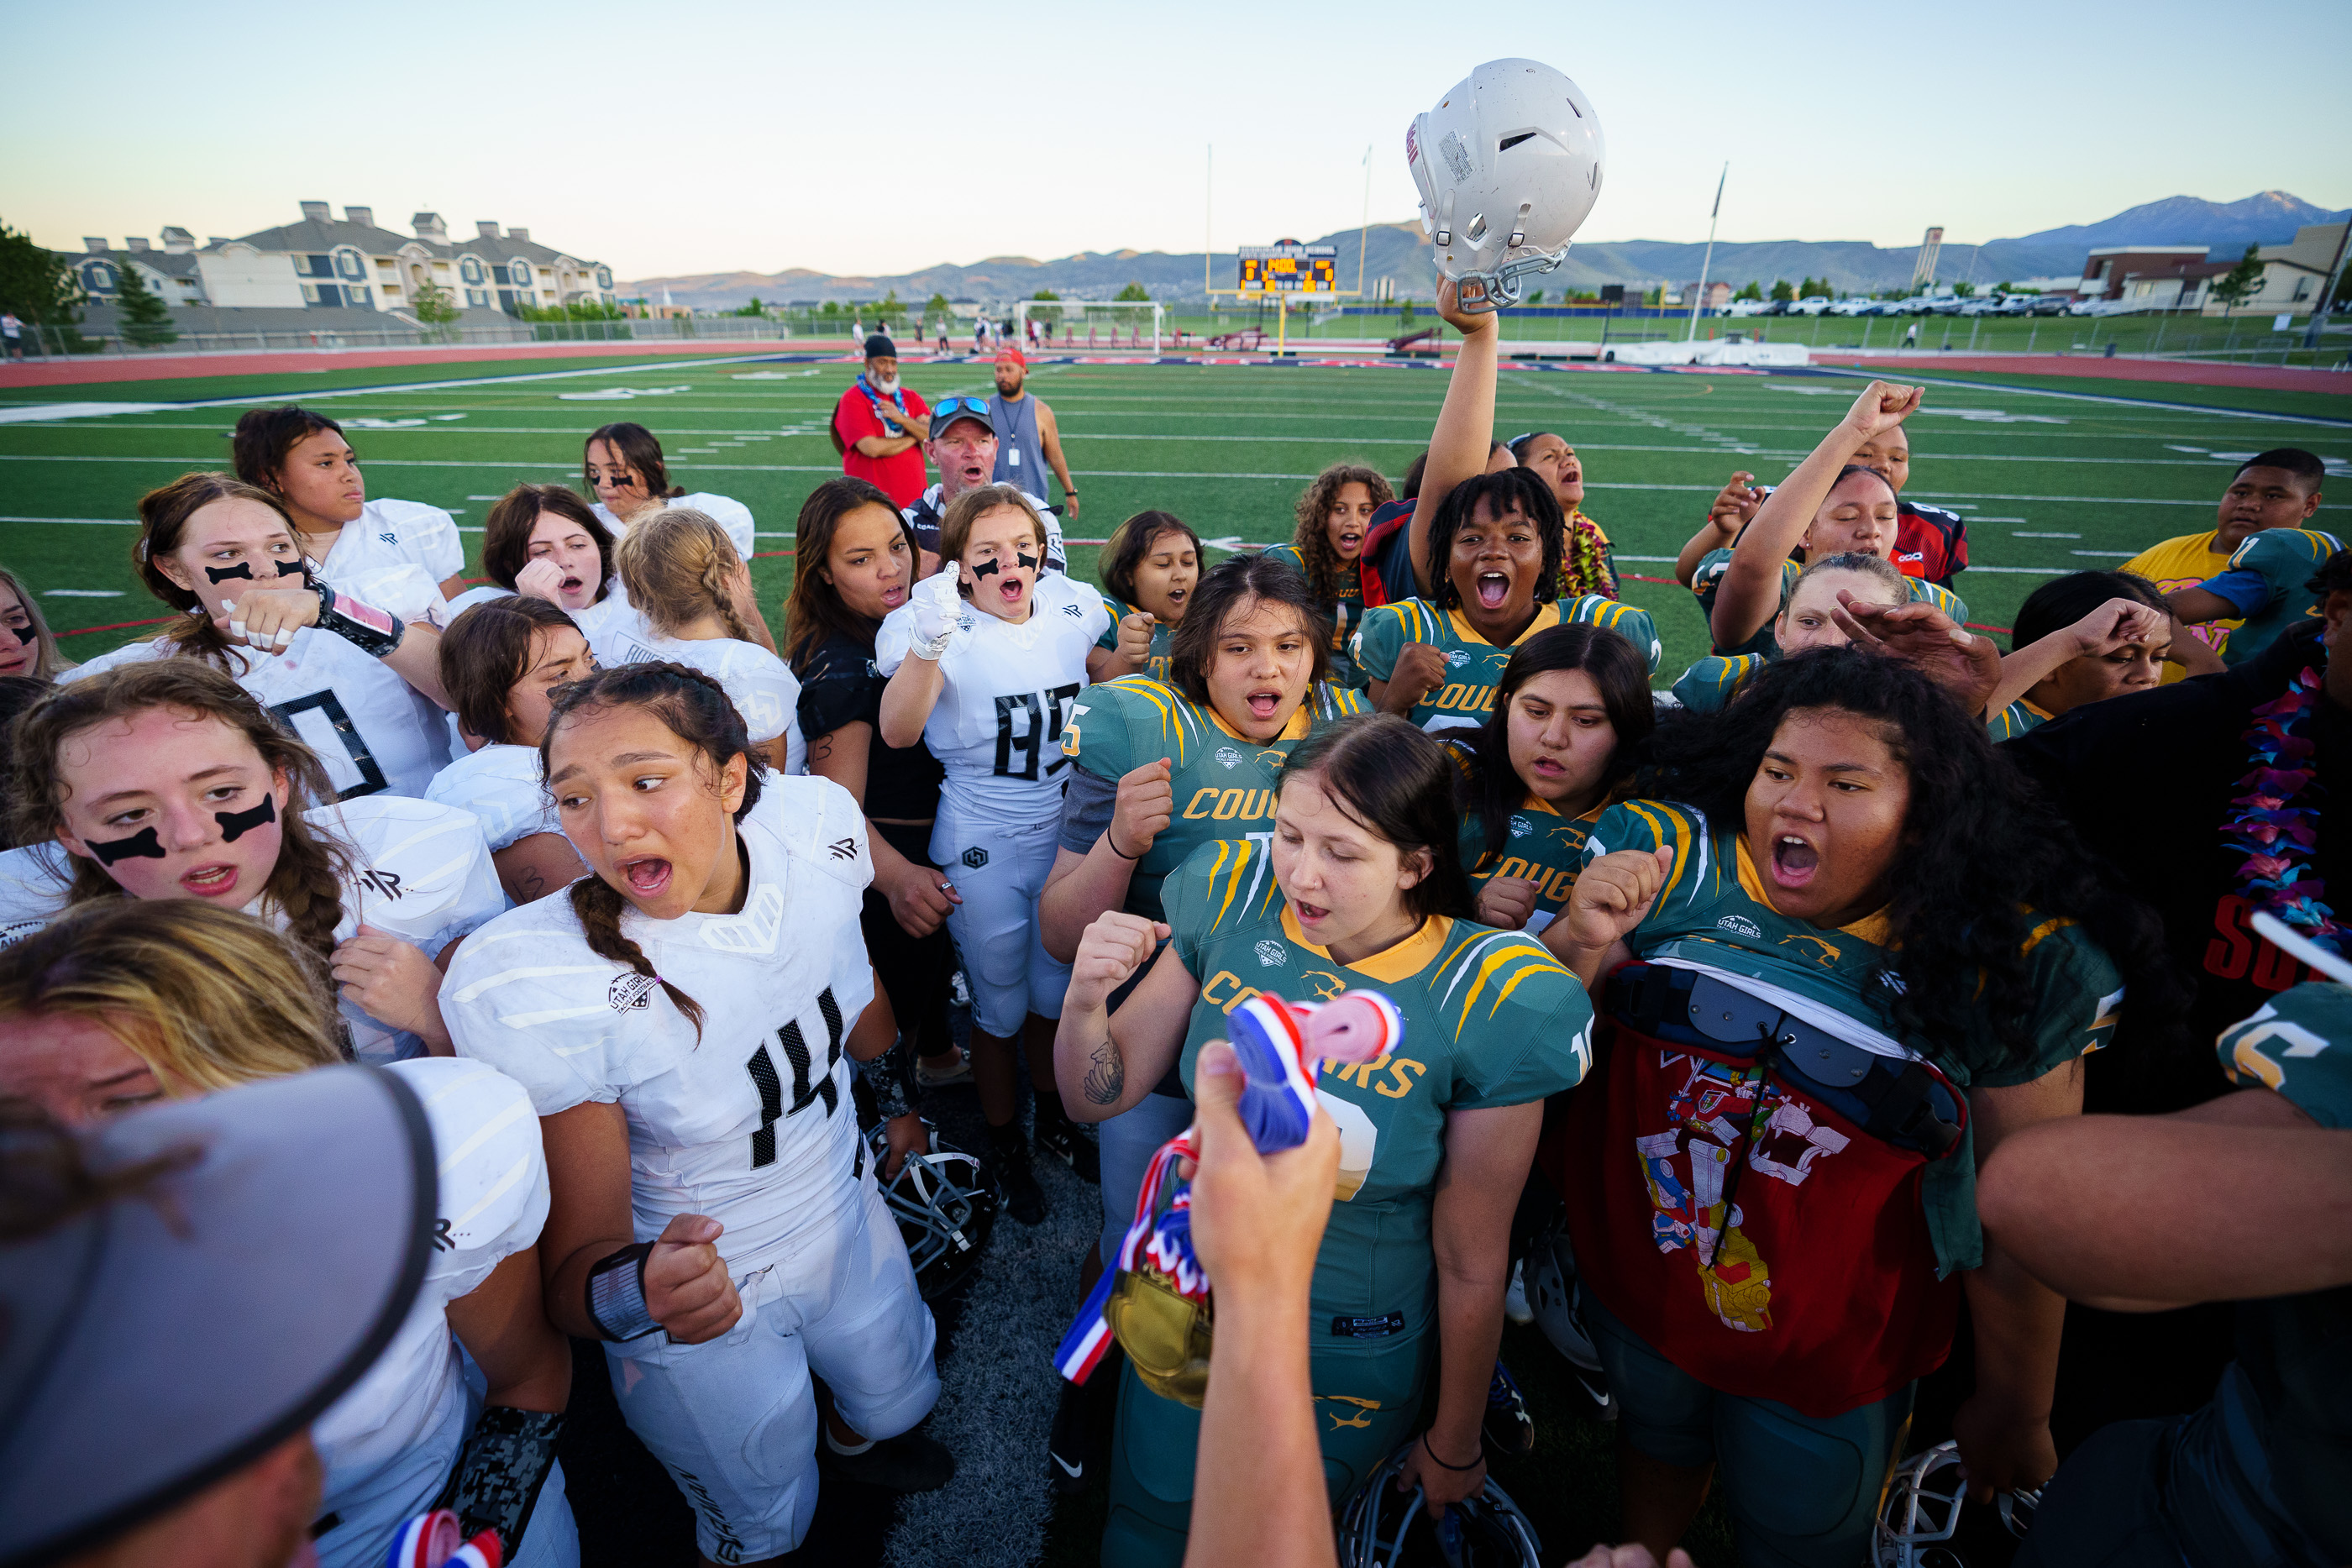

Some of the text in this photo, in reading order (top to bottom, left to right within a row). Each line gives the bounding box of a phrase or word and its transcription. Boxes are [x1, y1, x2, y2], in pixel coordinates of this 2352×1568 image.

[812, 733, 834, 763] 13
[1718, 918, 1739, 931] UTAH
[1739, 925, 1761, 939] GIRLS
[1256, 941, 1287, 963] UTAH GIRLS
[610, 986, 631, 1009] UTAH
[617, 996, 633, 1014] TACKLE
[743, 981, 845, 1172] 14
